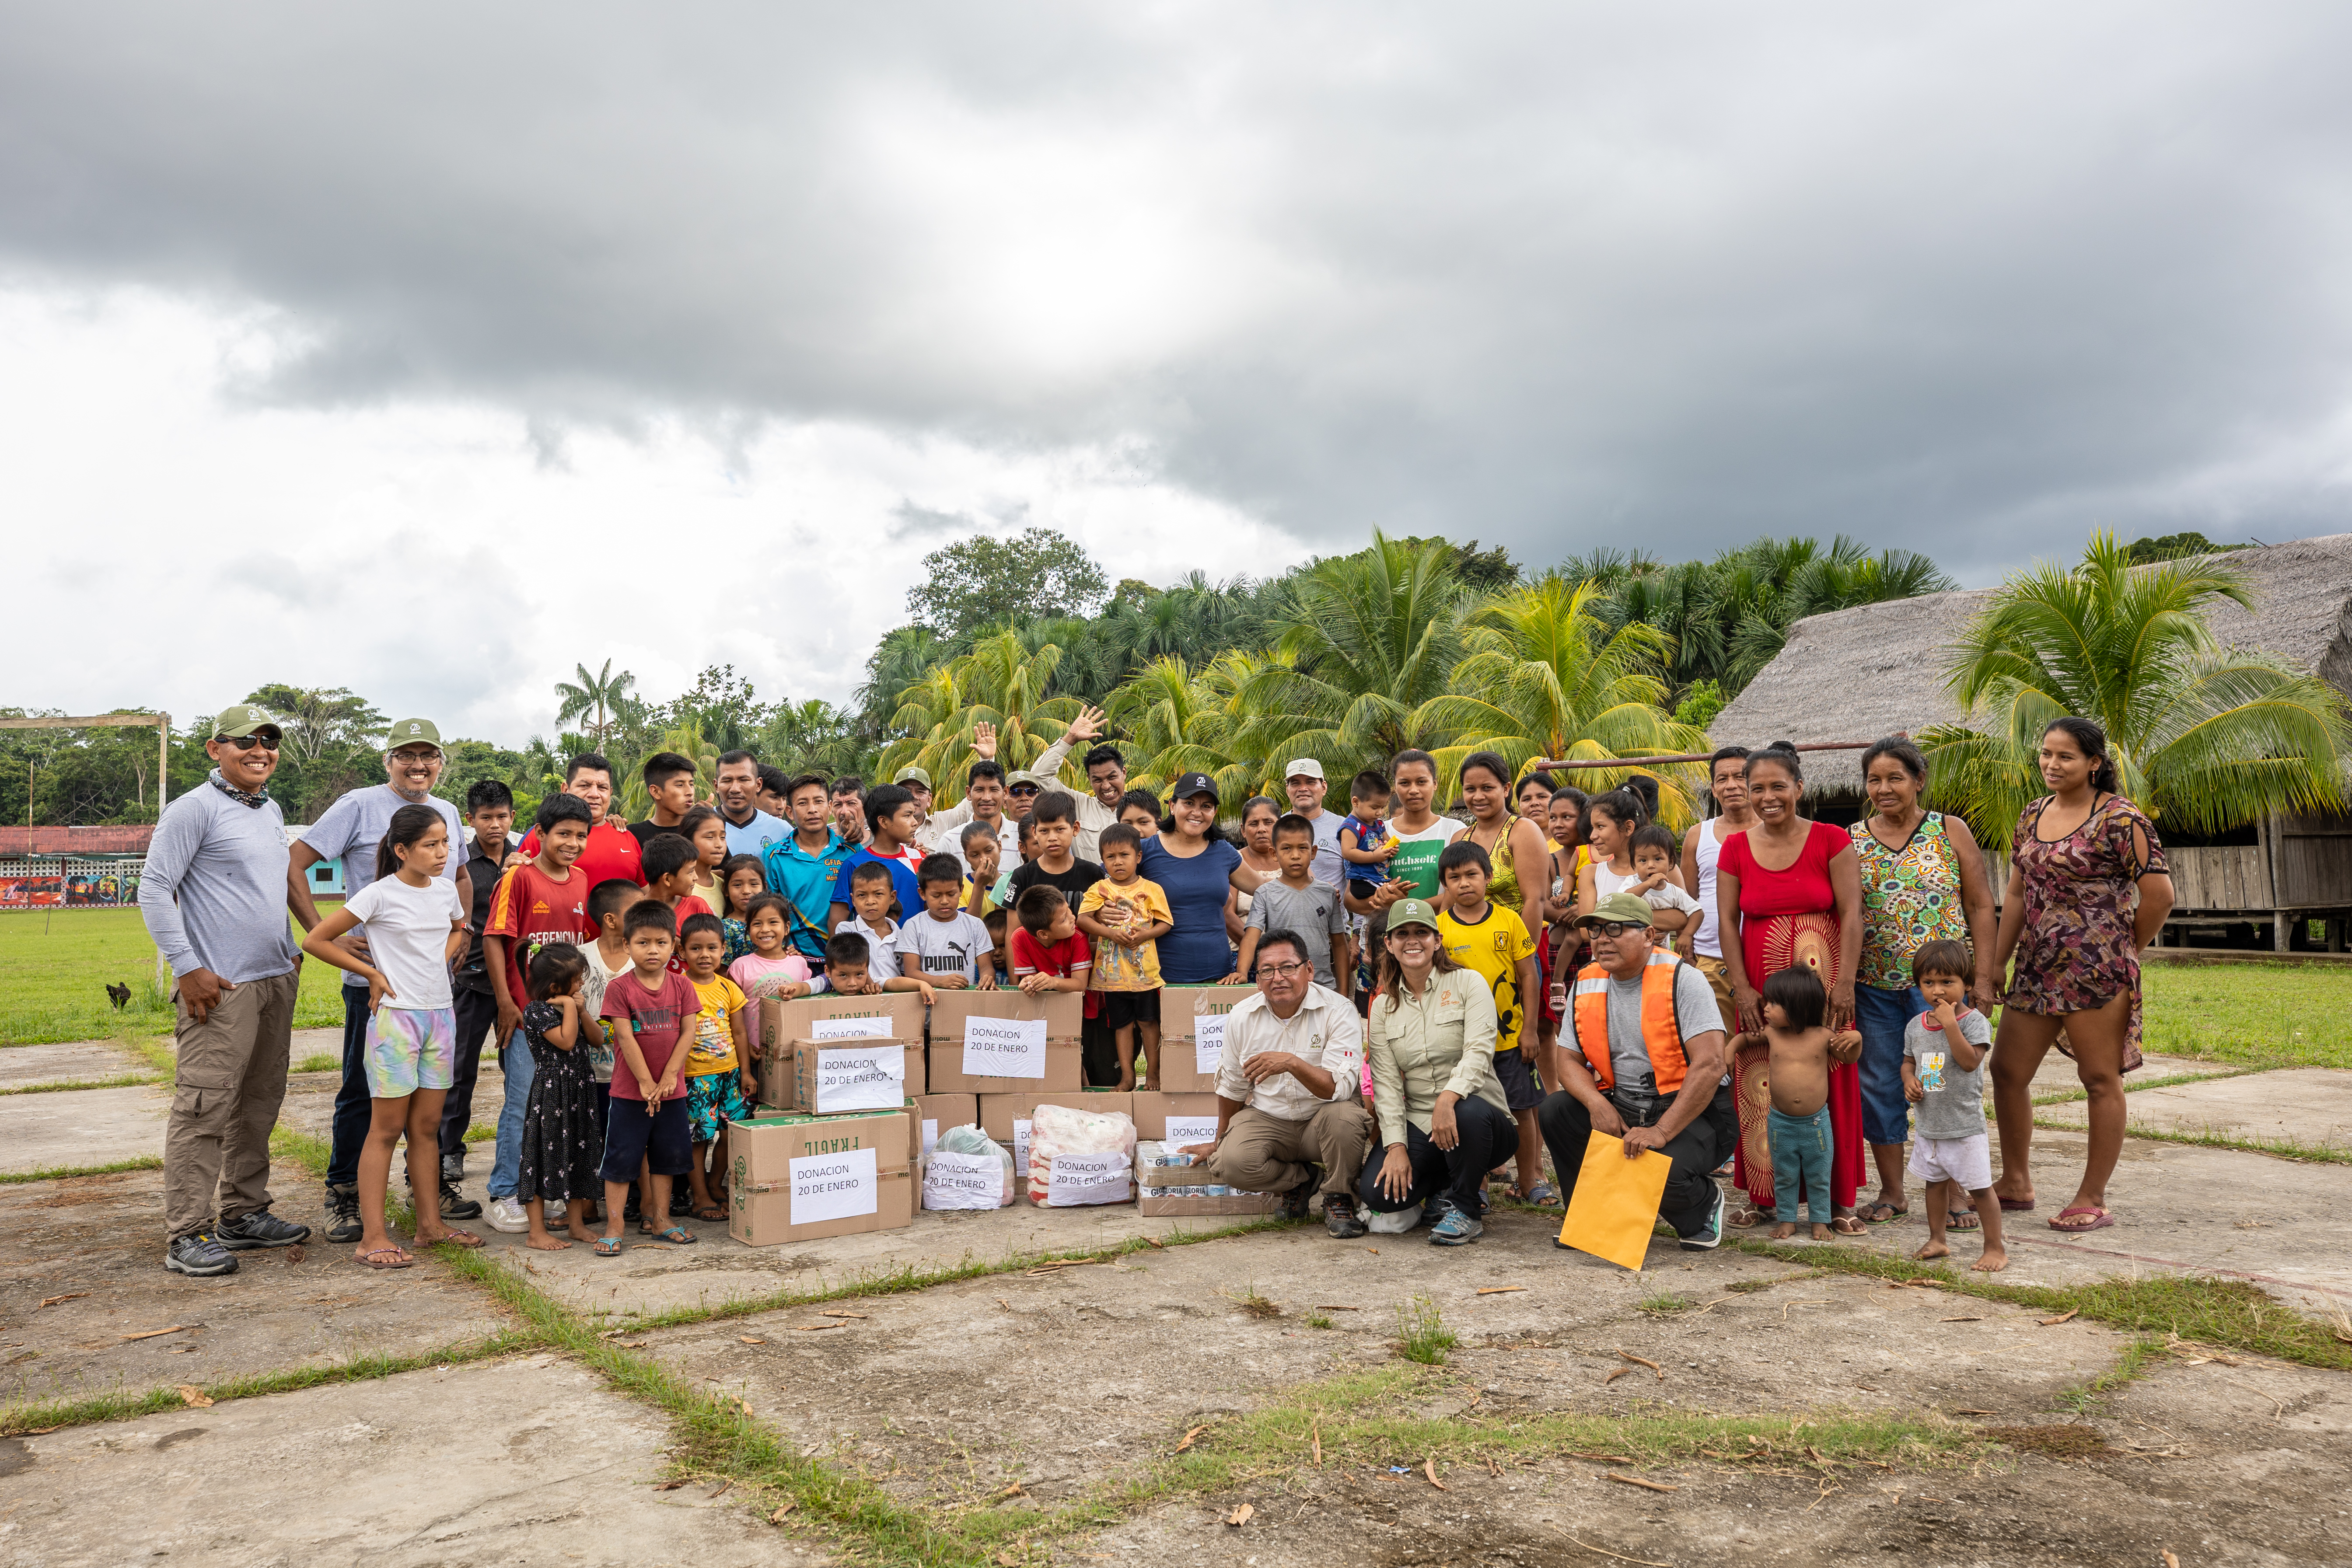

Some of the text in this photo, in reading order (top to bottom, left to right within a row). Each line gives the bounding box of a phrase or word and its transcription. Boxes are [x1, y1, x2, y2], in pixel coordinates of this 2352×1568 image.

[924, 955, 964, 972] PUMA
[972, 1028, 1020, 1039] DONACION
[971, 1042, 982, 1050] 20
[999, 1044, 1028, 1053] ENERO
[825, 1059, 876, 1069] DONACION
[1921, 1052, 1945, 1065] WILD
[825, 1076, 836, 1085] 20
[854, 1072, 884, 1083] ENERO
[1530, 1069, 1541, 1090] 7
[805, 1137, 859, 1157] FRAGIL
[798, 1164, 849, 1180] DONACION
[930, 1163, 978, 1174] DONACION
[1058, 1161, 1107, 1172] DONACION
[929, 1177, 986, 1189] 20 DE ENERO
[1070, 1177, 1082, 1185] DE
[1085, 1175, 1115, 1184] ENERO
[798, 1179, 859, 1196] 20 DE ENERO
[1185, 1187, 1206, 1195] GLORIA
